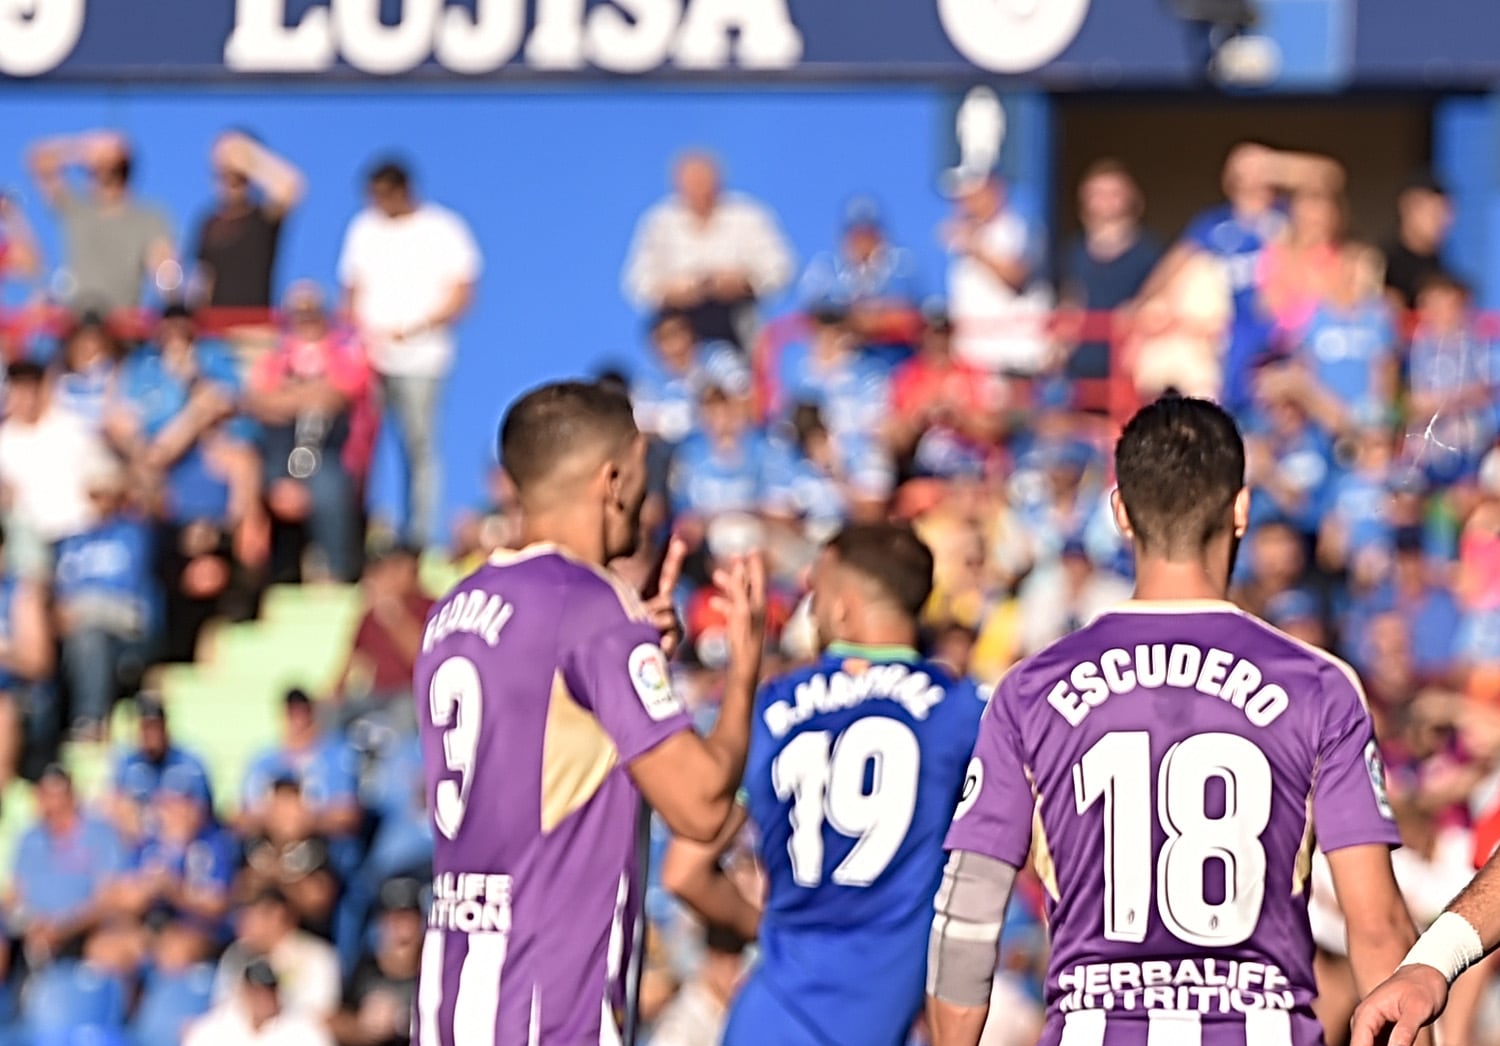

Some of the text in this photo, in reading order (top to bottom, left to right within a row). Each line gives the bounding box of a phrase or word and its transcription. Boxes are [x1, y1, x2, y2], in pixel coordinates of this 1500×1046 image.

[429, 656, 483, 840] 3
[1047, 643, 1289, 728] ESCUDERO
[771, 716, 921, 888] 19
[1072, 731, 1272, 948] 18
